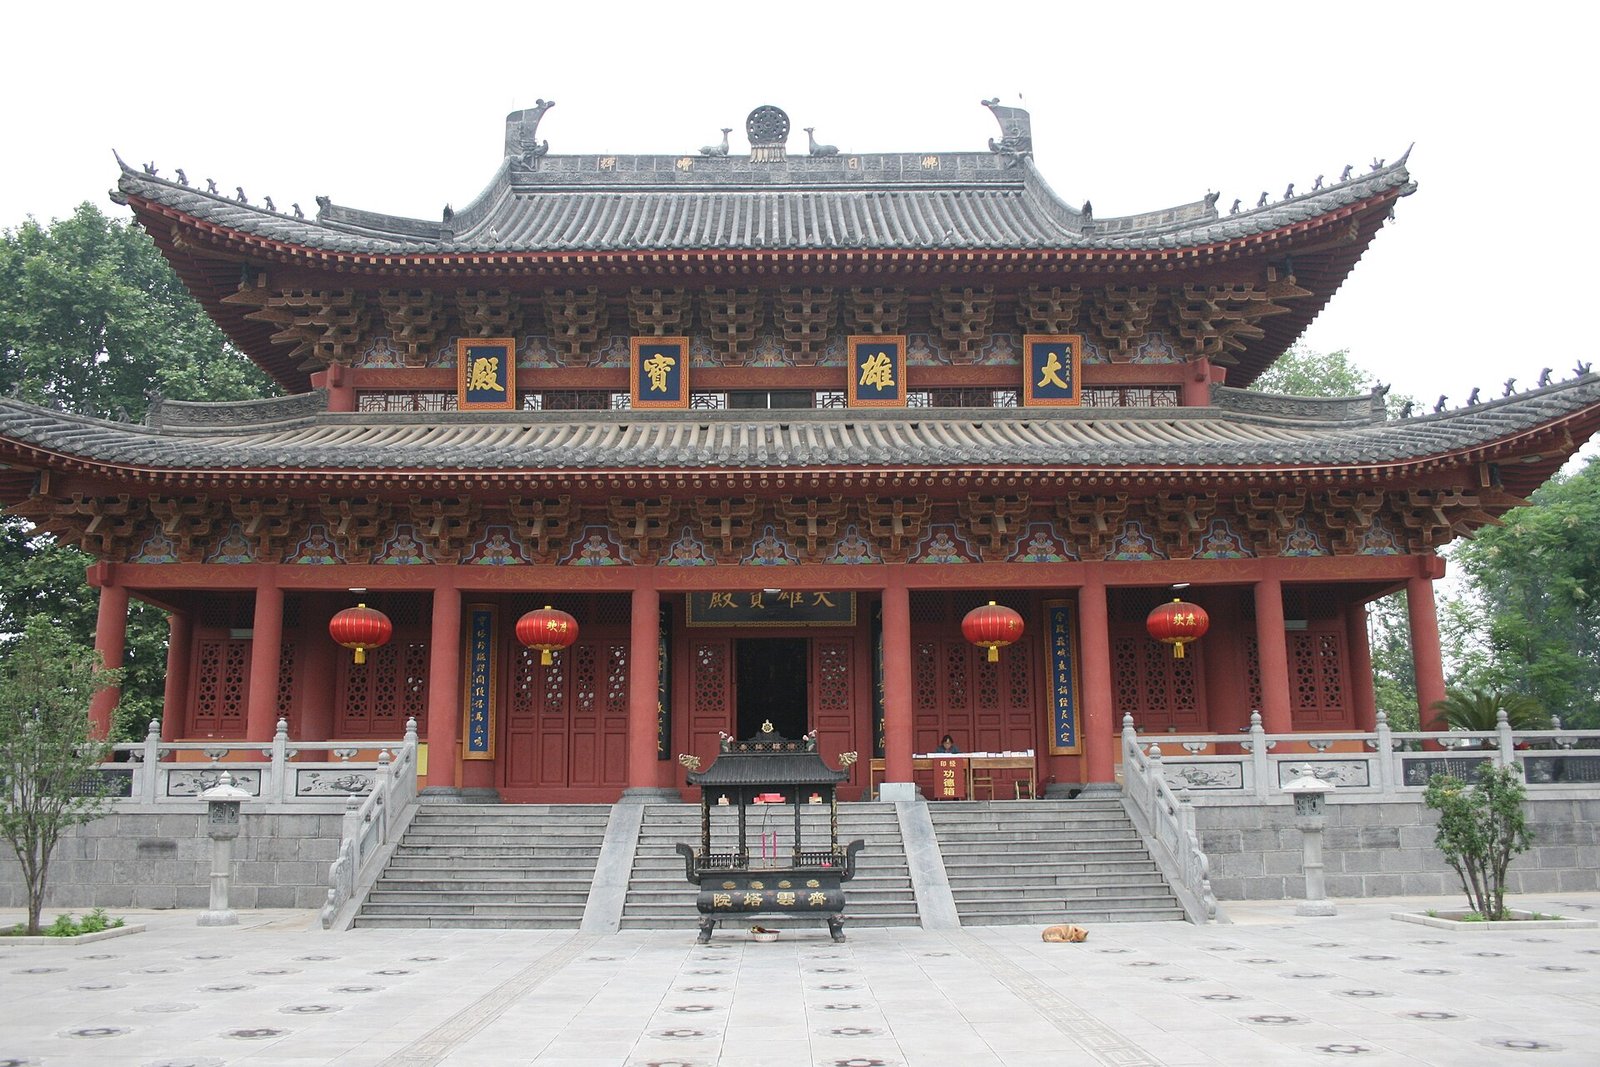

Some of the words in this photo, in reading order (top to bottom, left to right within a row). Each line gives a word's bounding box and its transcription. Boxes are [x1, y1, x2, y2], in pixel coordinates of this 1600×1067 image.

[469, 356, 505, 392] 殿
[643, 353, 676, 393] 寶
[859, 351, 895, 392] 雄
[1037, 352, 1068, 390] 大
[943, 769, 955, 796] 功德箱
